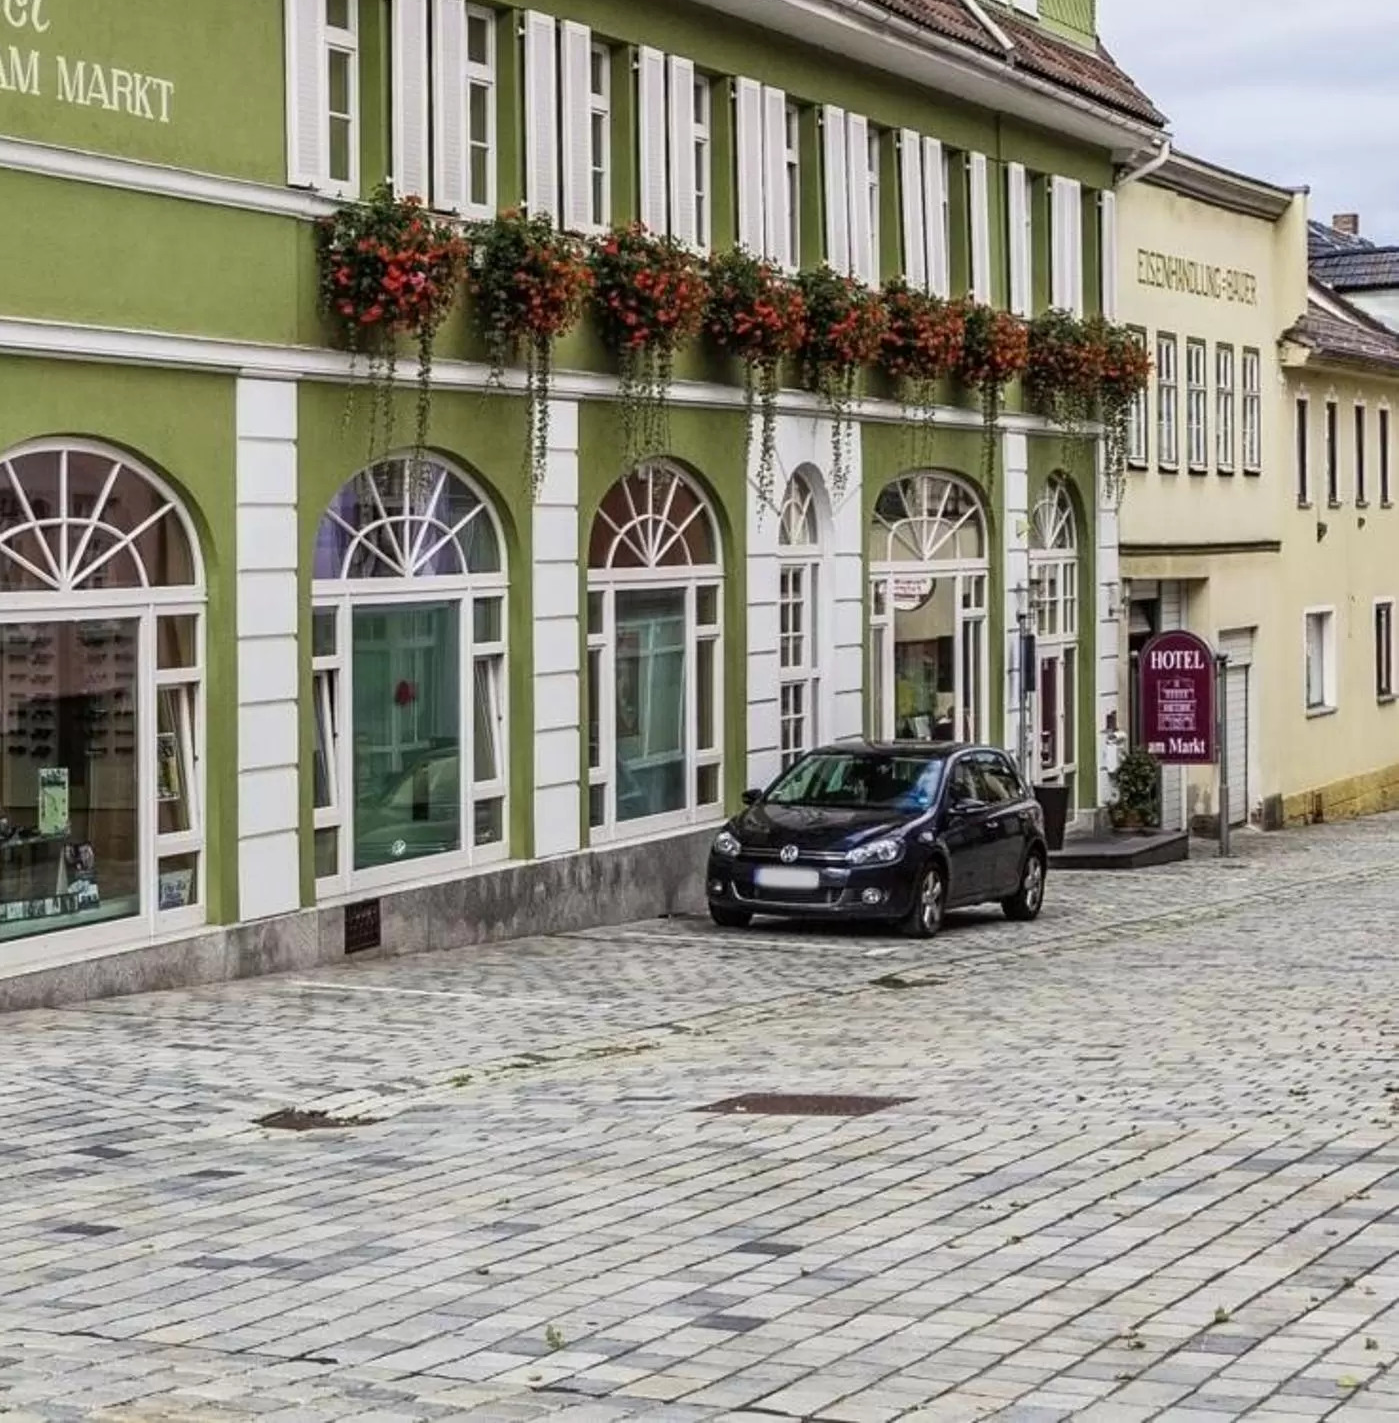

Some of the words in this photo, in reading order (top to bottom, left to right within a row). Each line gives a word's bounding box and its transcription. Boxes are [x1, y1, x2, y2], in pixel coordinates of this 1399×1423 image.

[56, 54, 174, 124] MARKT
[1151, 650, 1204, 669] HOTEL
[1147, 741, 1165, 754] am
[1168, 737, 1206, 754] Markt
